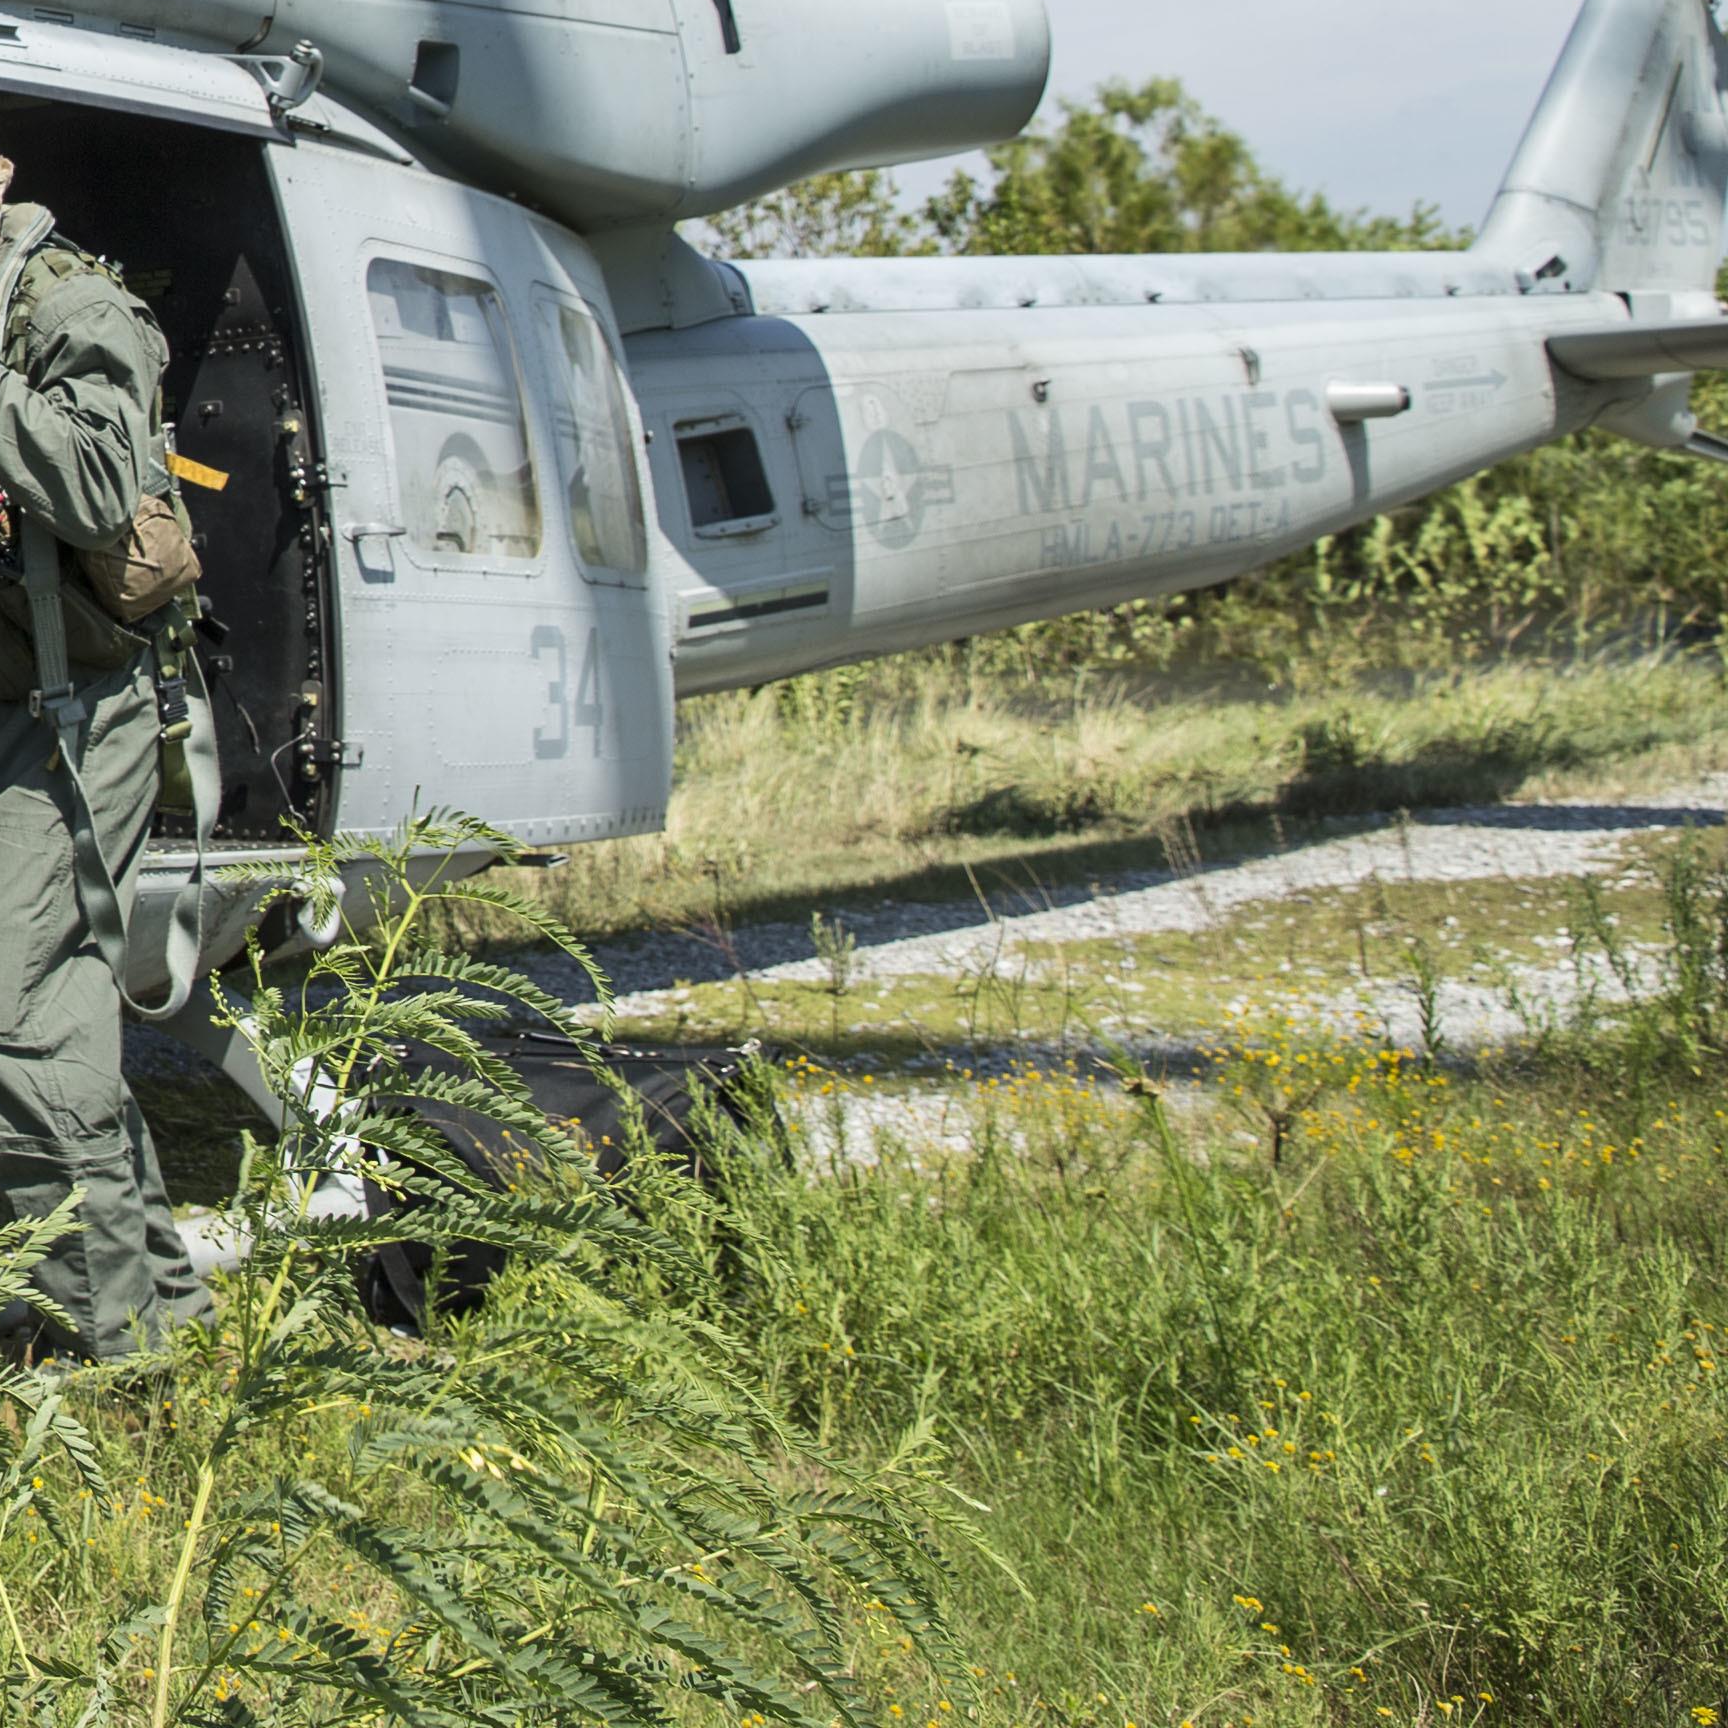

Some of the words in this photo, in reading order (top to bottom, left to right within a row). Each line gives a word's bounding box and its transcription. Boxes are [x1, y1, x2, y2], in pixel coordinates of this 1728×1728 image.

[1007, 389, 1326, 515] MARINES
[1040, 509, 1197, 569] HMLA-773
[531, 625, 604, 760] 34
